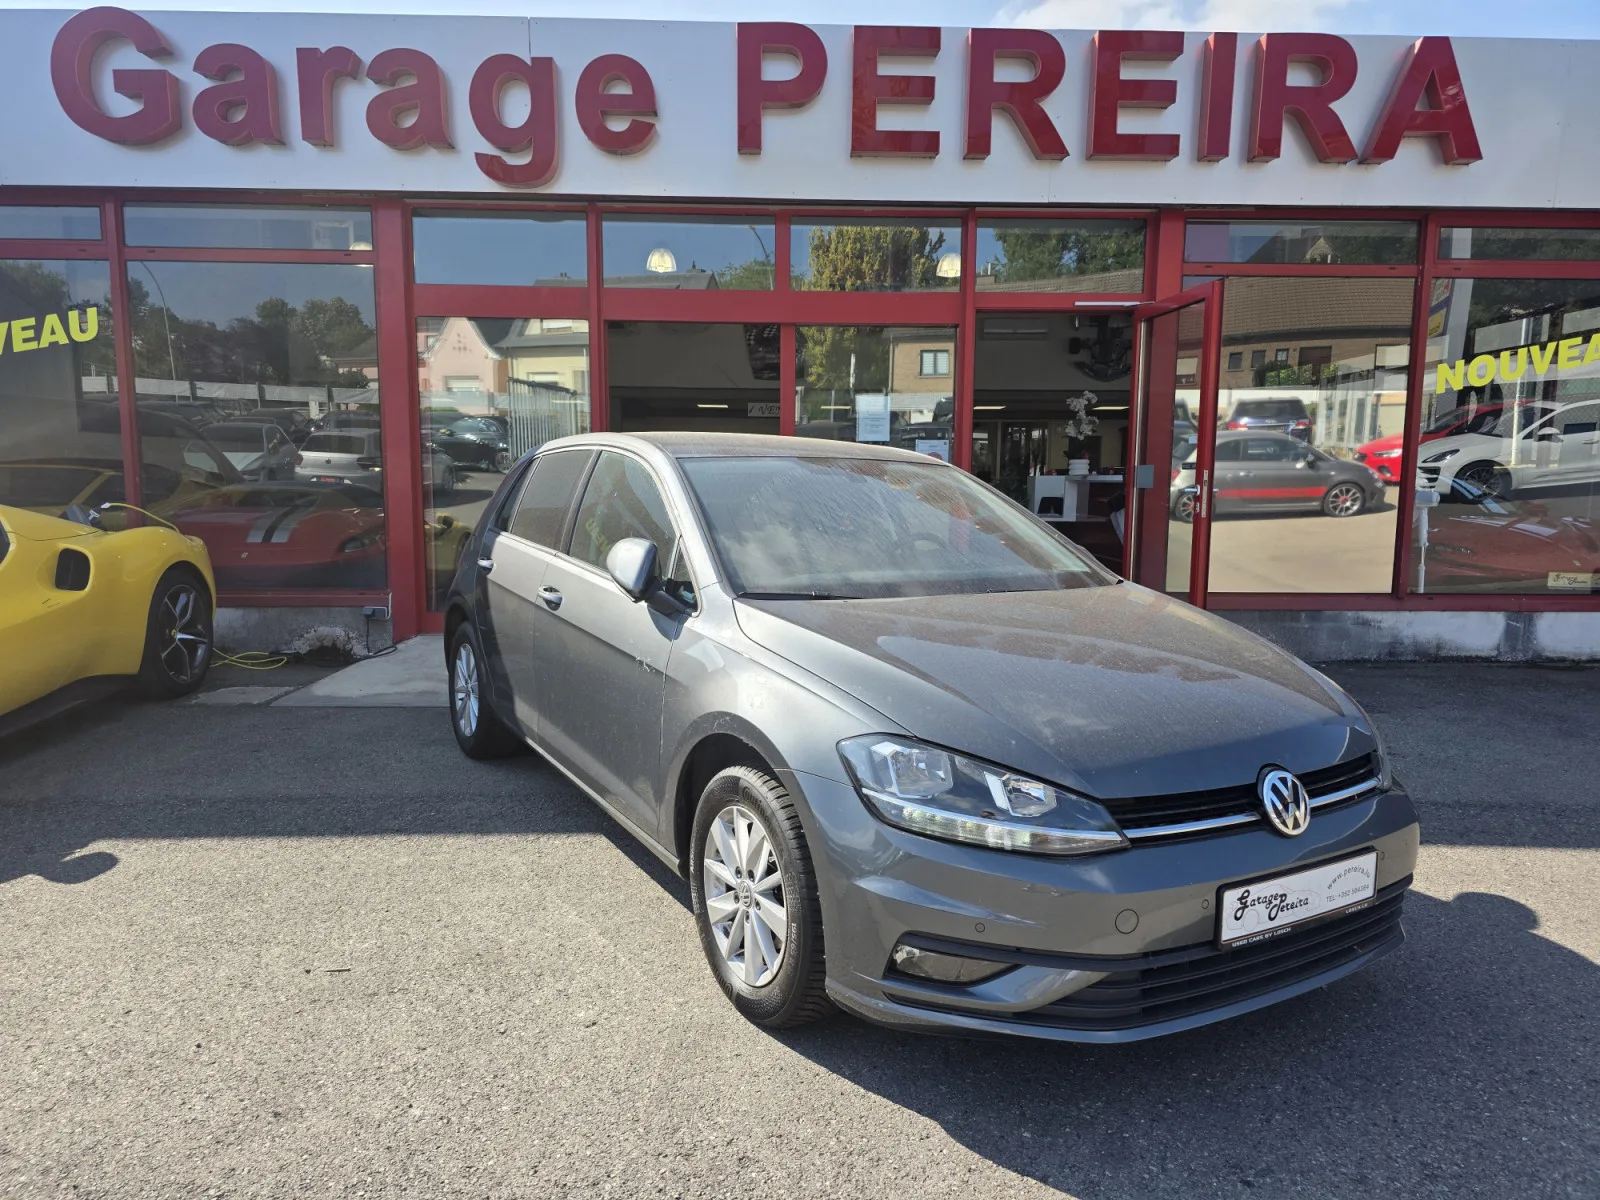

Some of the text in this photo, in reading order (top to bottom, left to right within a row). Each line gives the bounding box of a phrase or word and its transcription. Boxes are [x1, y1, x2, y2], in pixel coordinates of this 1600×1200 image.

[50, 6, 1483, 189] Garage PEREIRA
[1233, 889, 1279, 922] Garage
[1267, 892, 1309, 922] Pereira
